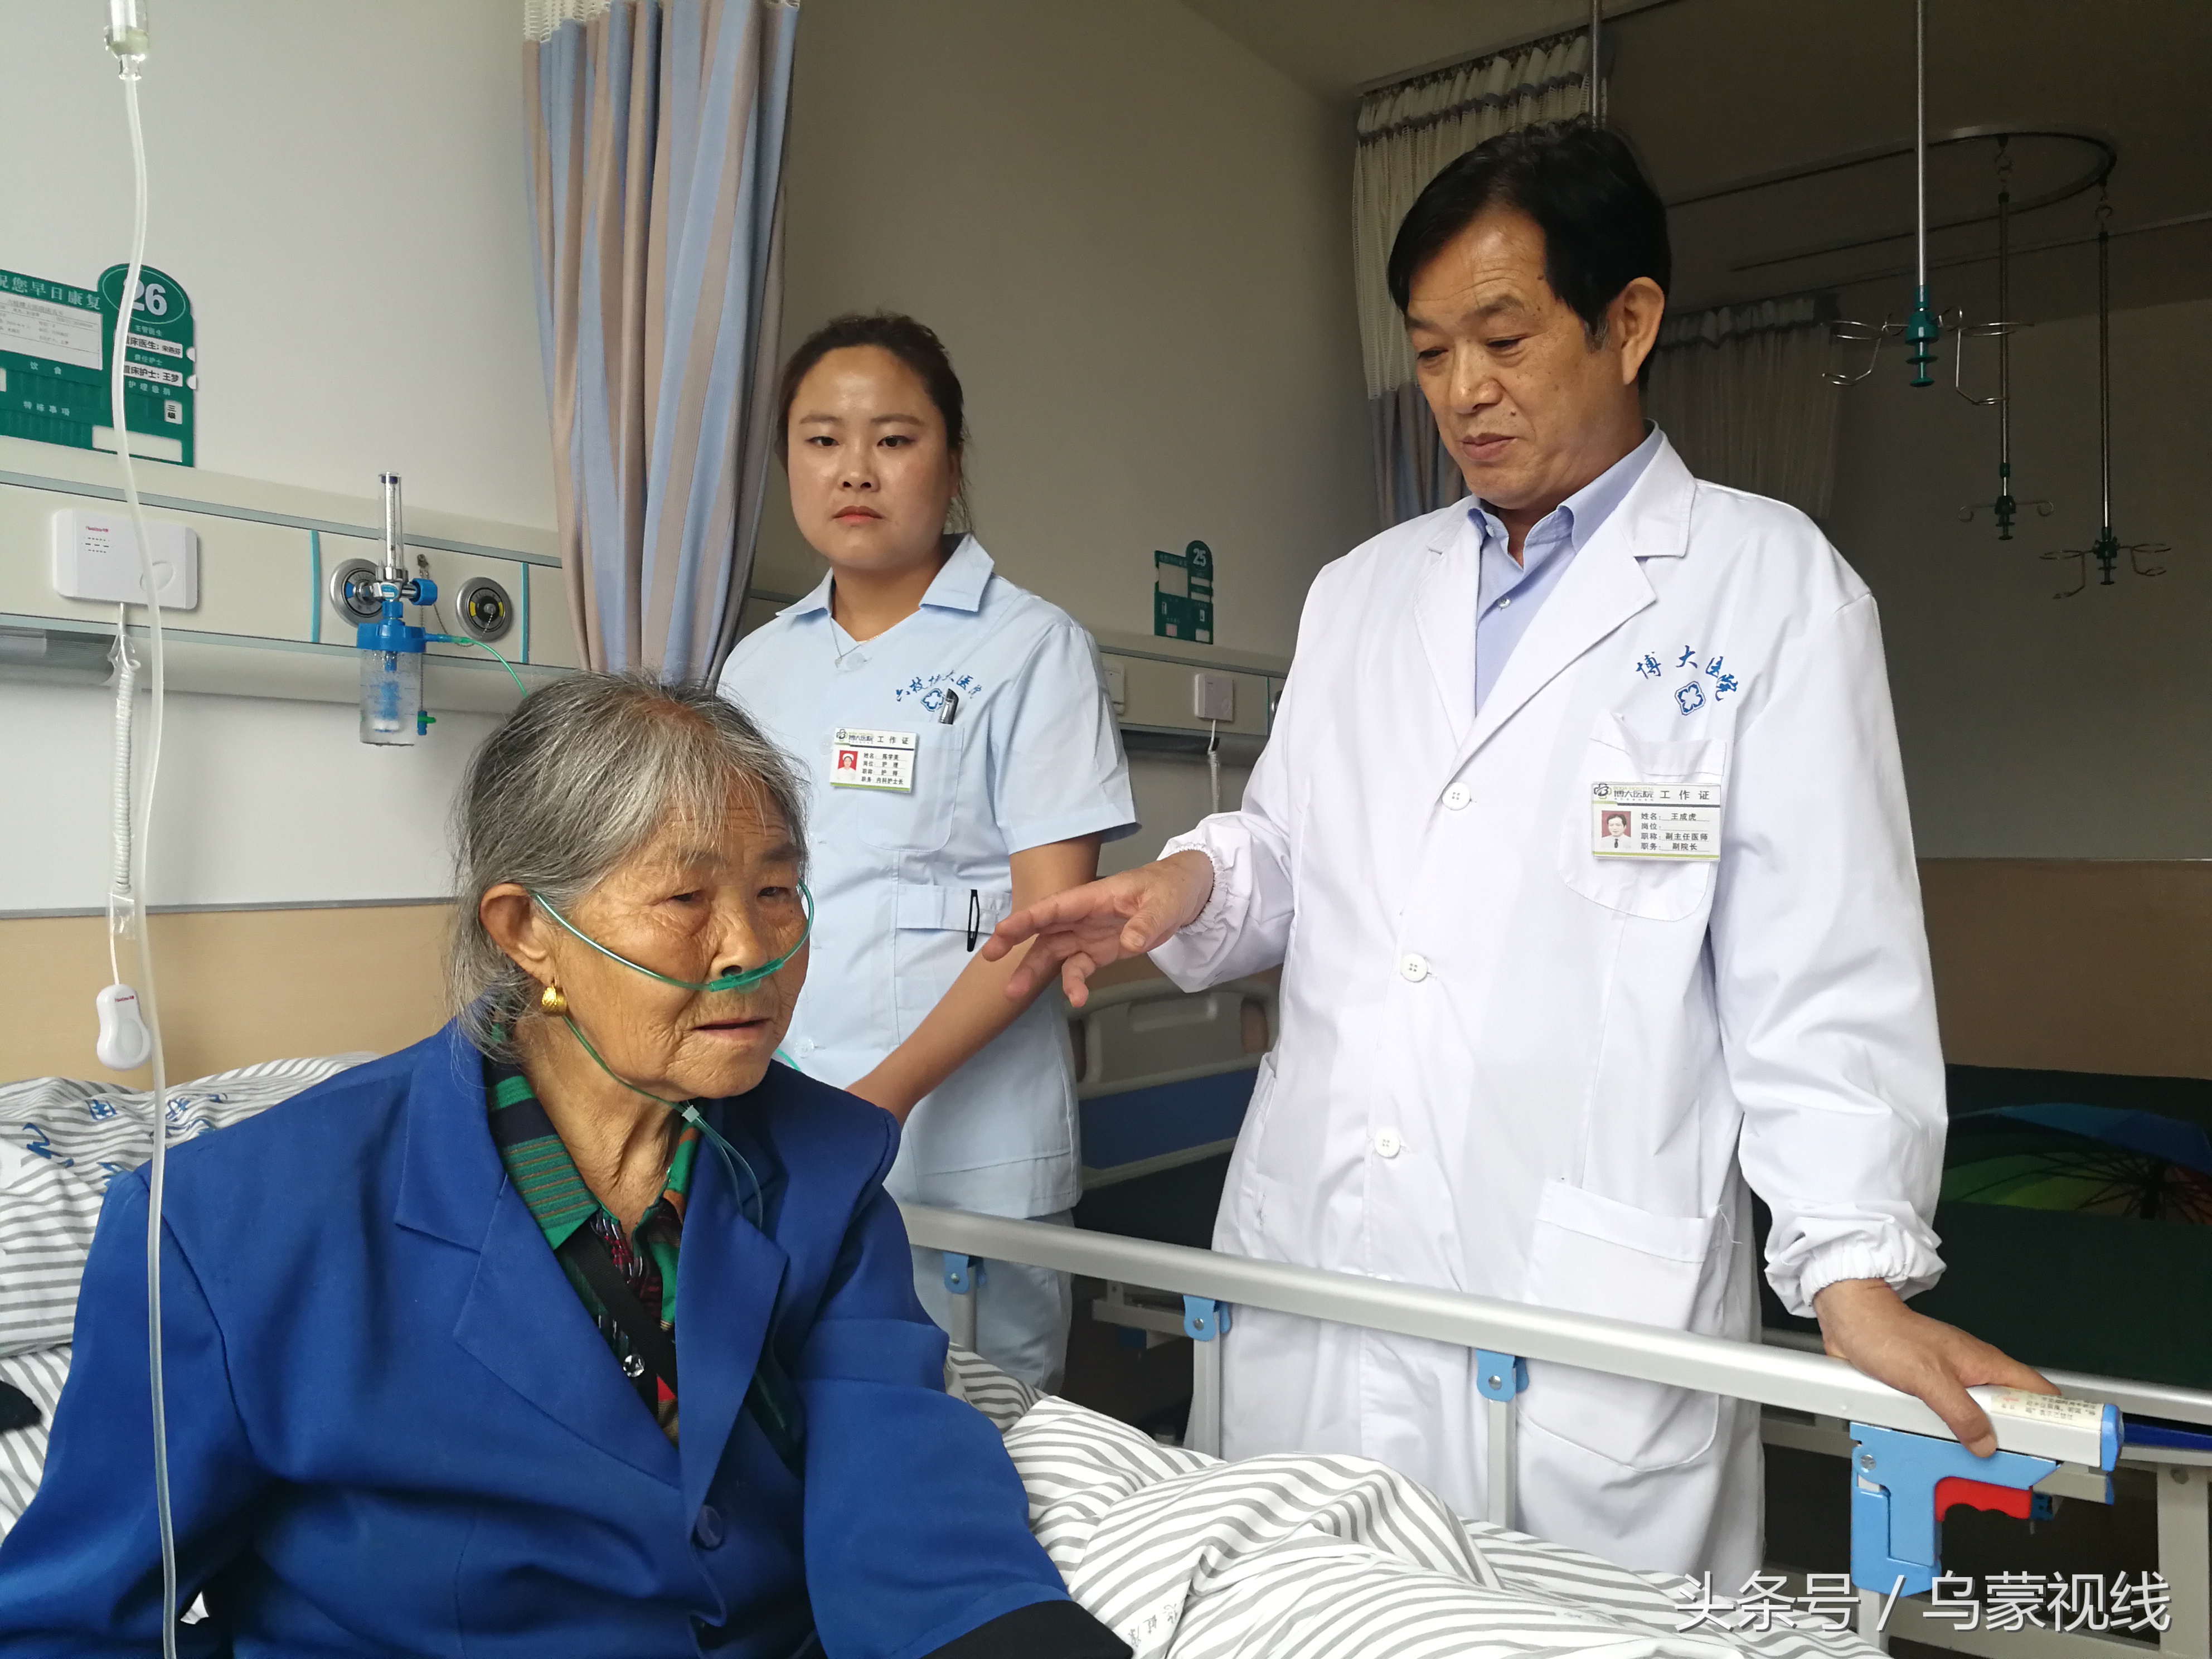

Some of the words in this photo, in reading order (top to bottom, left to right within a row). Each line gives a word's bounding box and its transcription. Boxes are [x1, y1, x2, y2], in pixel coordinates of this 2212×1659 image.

[124, 278, 167, 316] 26
[1193, 548, 1206, 567] 25
[877, 735, 909, 745] 工作证
[1614, 790, 1654, 798] 博大医院
[1660, 790, 1710, 800] 工作证
[1666, 832, 1708, 841] 副主任医师
[1672, 842, 1697, 851] 副院长
